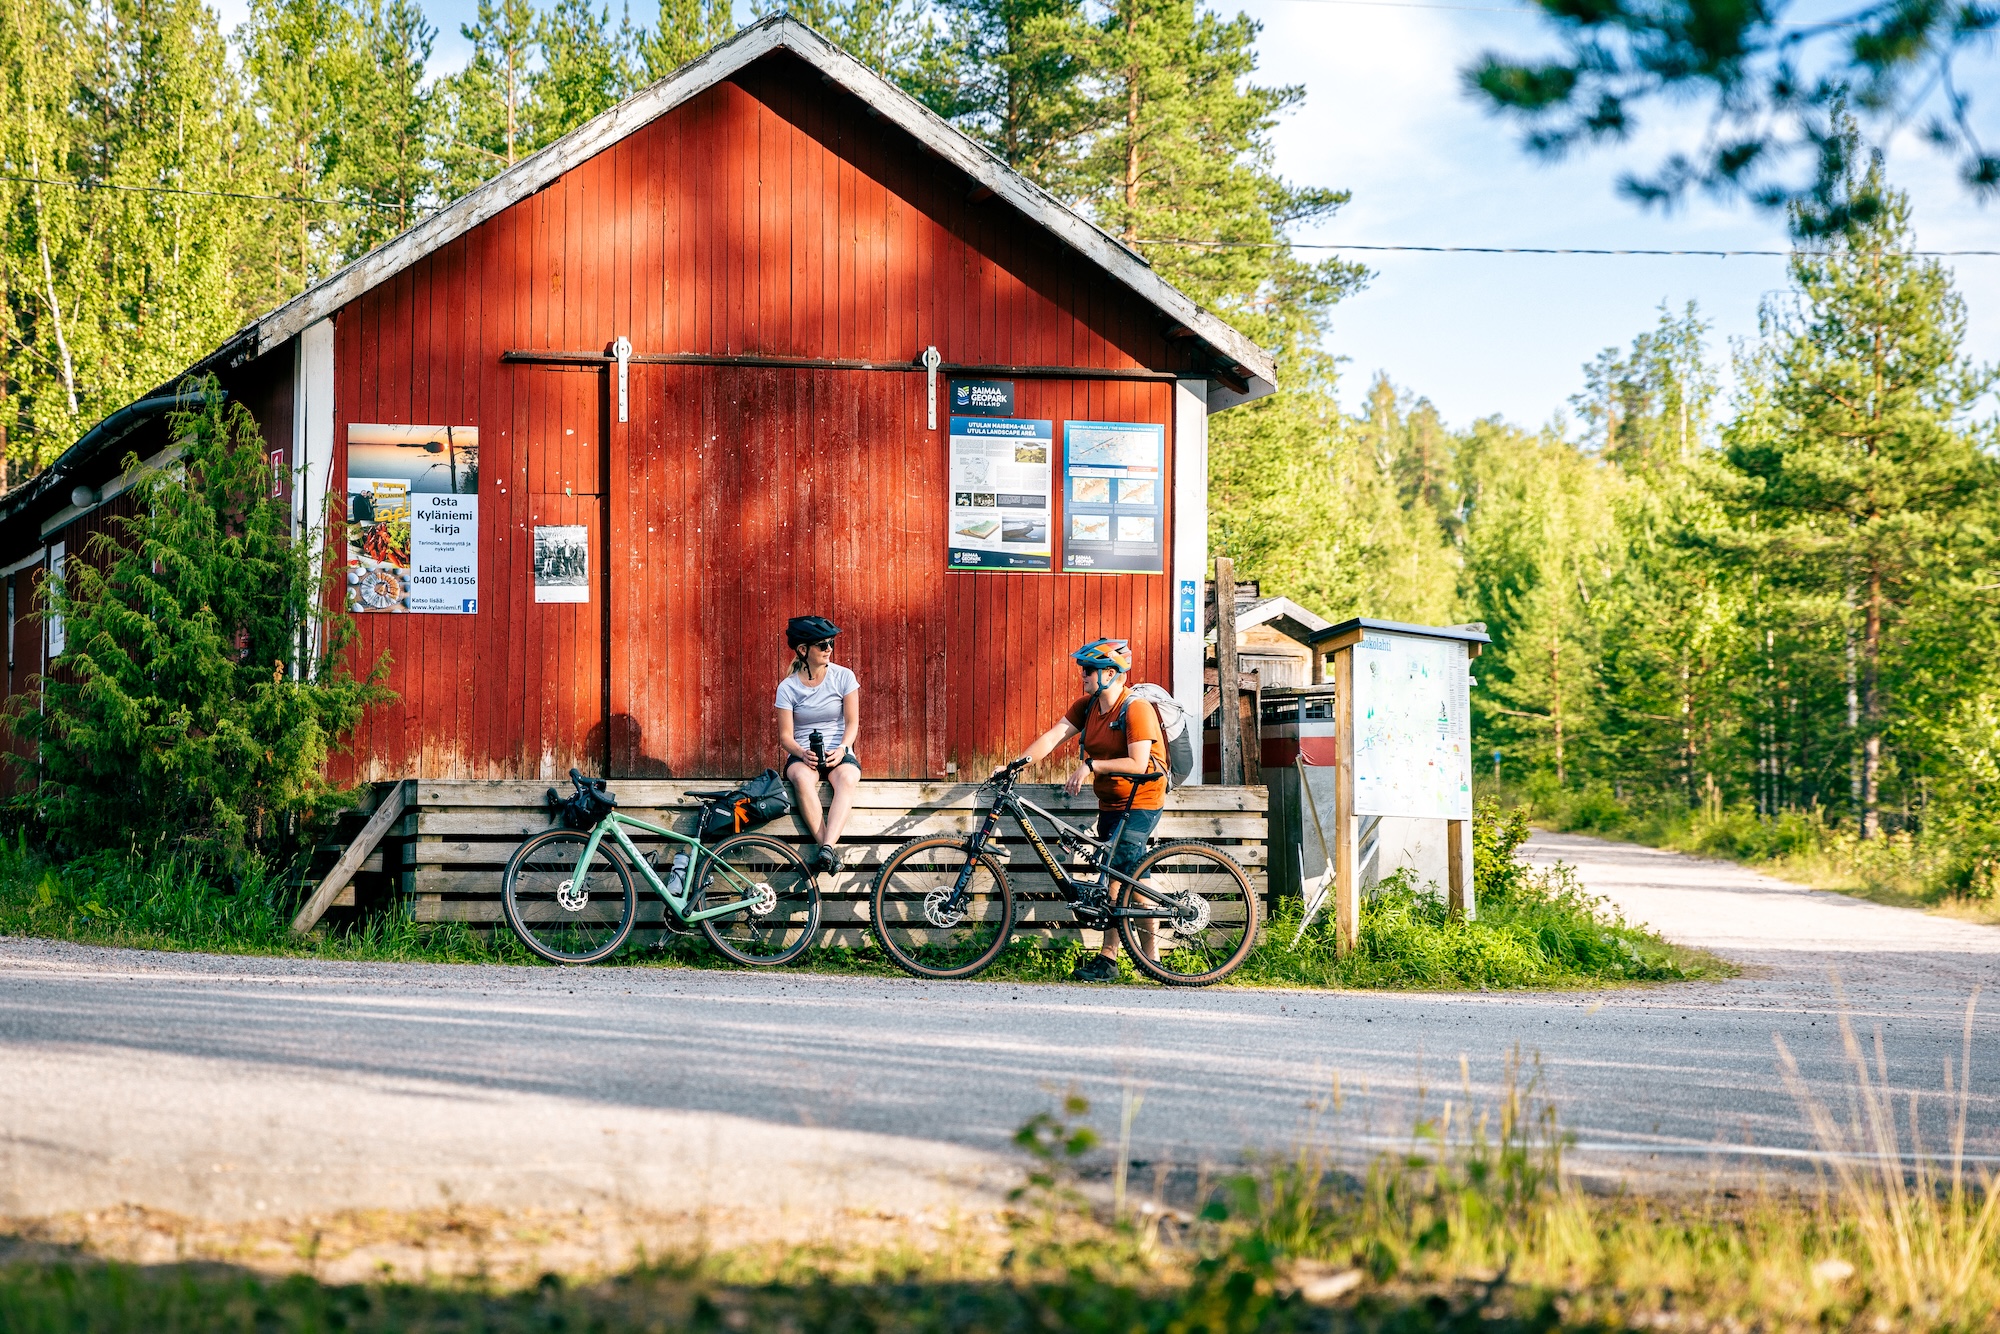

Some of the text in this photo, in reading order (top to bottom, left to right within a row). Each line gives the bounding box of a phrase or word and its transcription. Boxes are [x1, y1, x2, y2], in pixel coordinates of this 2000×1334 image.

[972, 386, 1002, 396] SAIMAA
[971, 394, 1007, 403] GEOPARK
[992, 423, 1035, 431] MAISEMA-ALUE
[432, 497, 458, 507] Osta
[417, 510, 473, 521] Kyläniemi
[430, 524, 460, 536] -kirja
[419, 564, 470, 573] Laita viesti
[413, 576, 476, 585] 0400 141056
[1021, 818, 1064, 880] ROCKY MOUNTAIN
[618, 830, 664, 891] ORBEA
